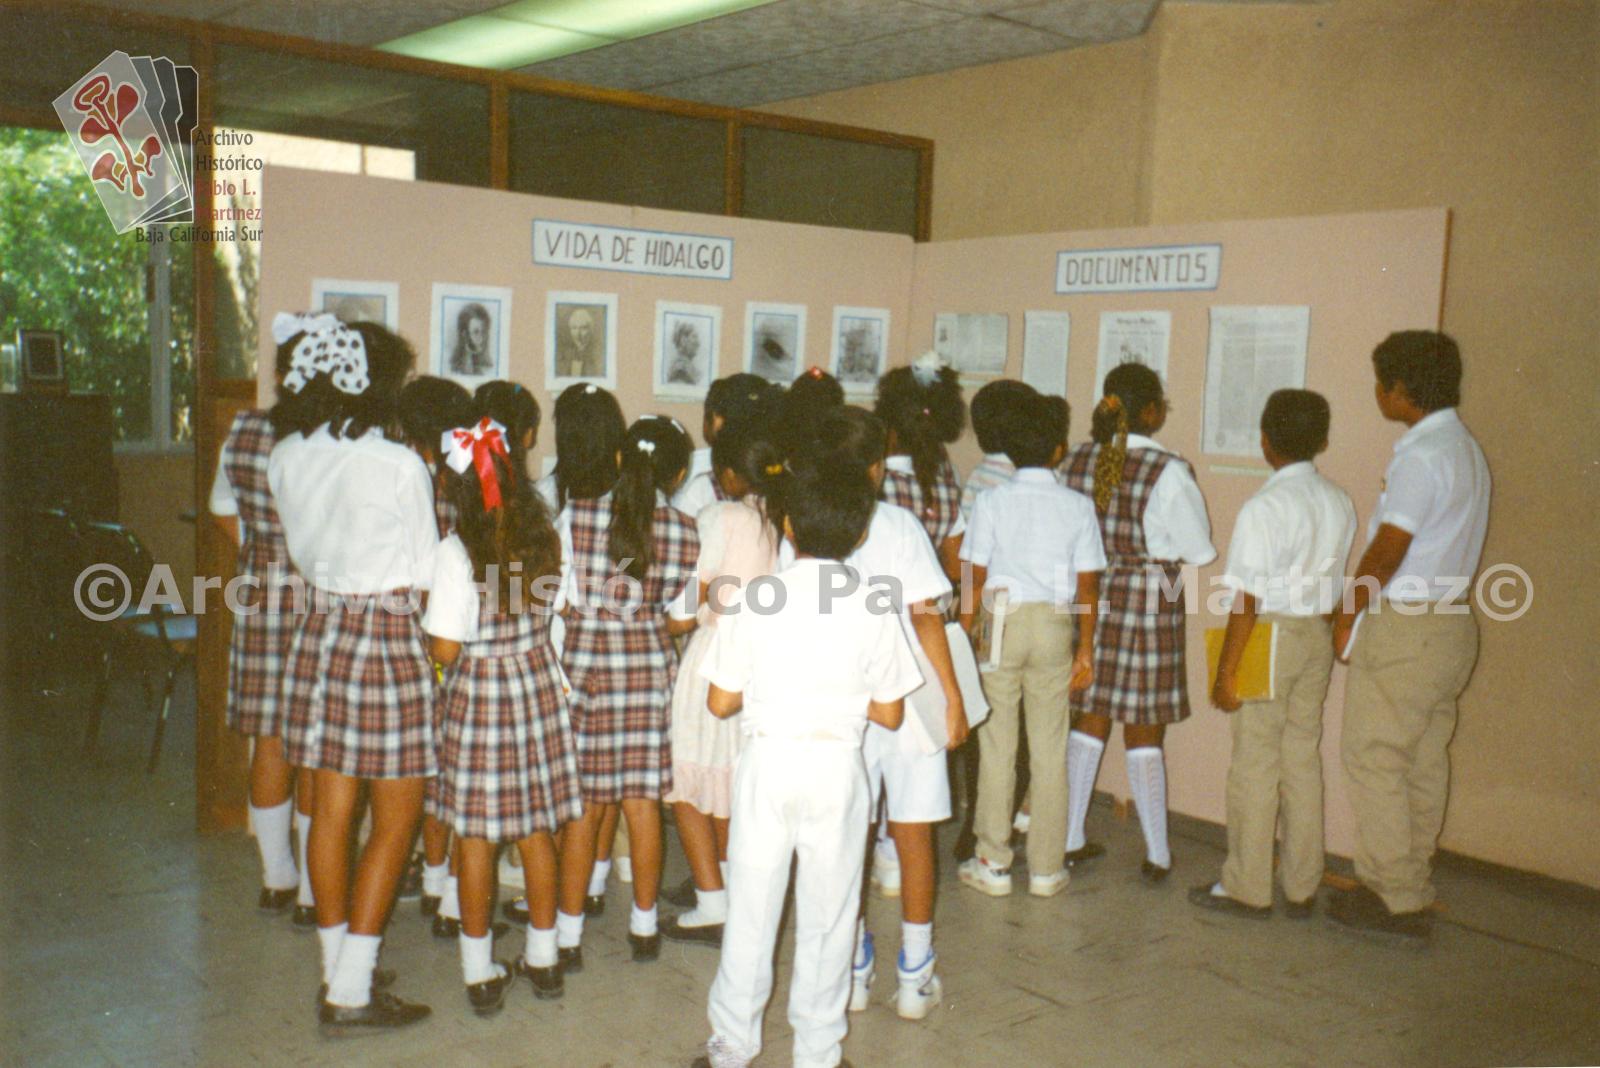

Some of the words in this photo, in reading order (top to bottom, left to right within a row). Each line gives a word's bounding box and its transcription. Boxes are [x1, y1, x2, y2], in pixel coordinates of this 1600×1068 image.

[545, 229, 603, 262] VIDA
[611, 236, 636, 265] DE
[644, 239, 724, 271] HIDALGO
[1065, 253, 1208, 286] DOCUMENTOS
